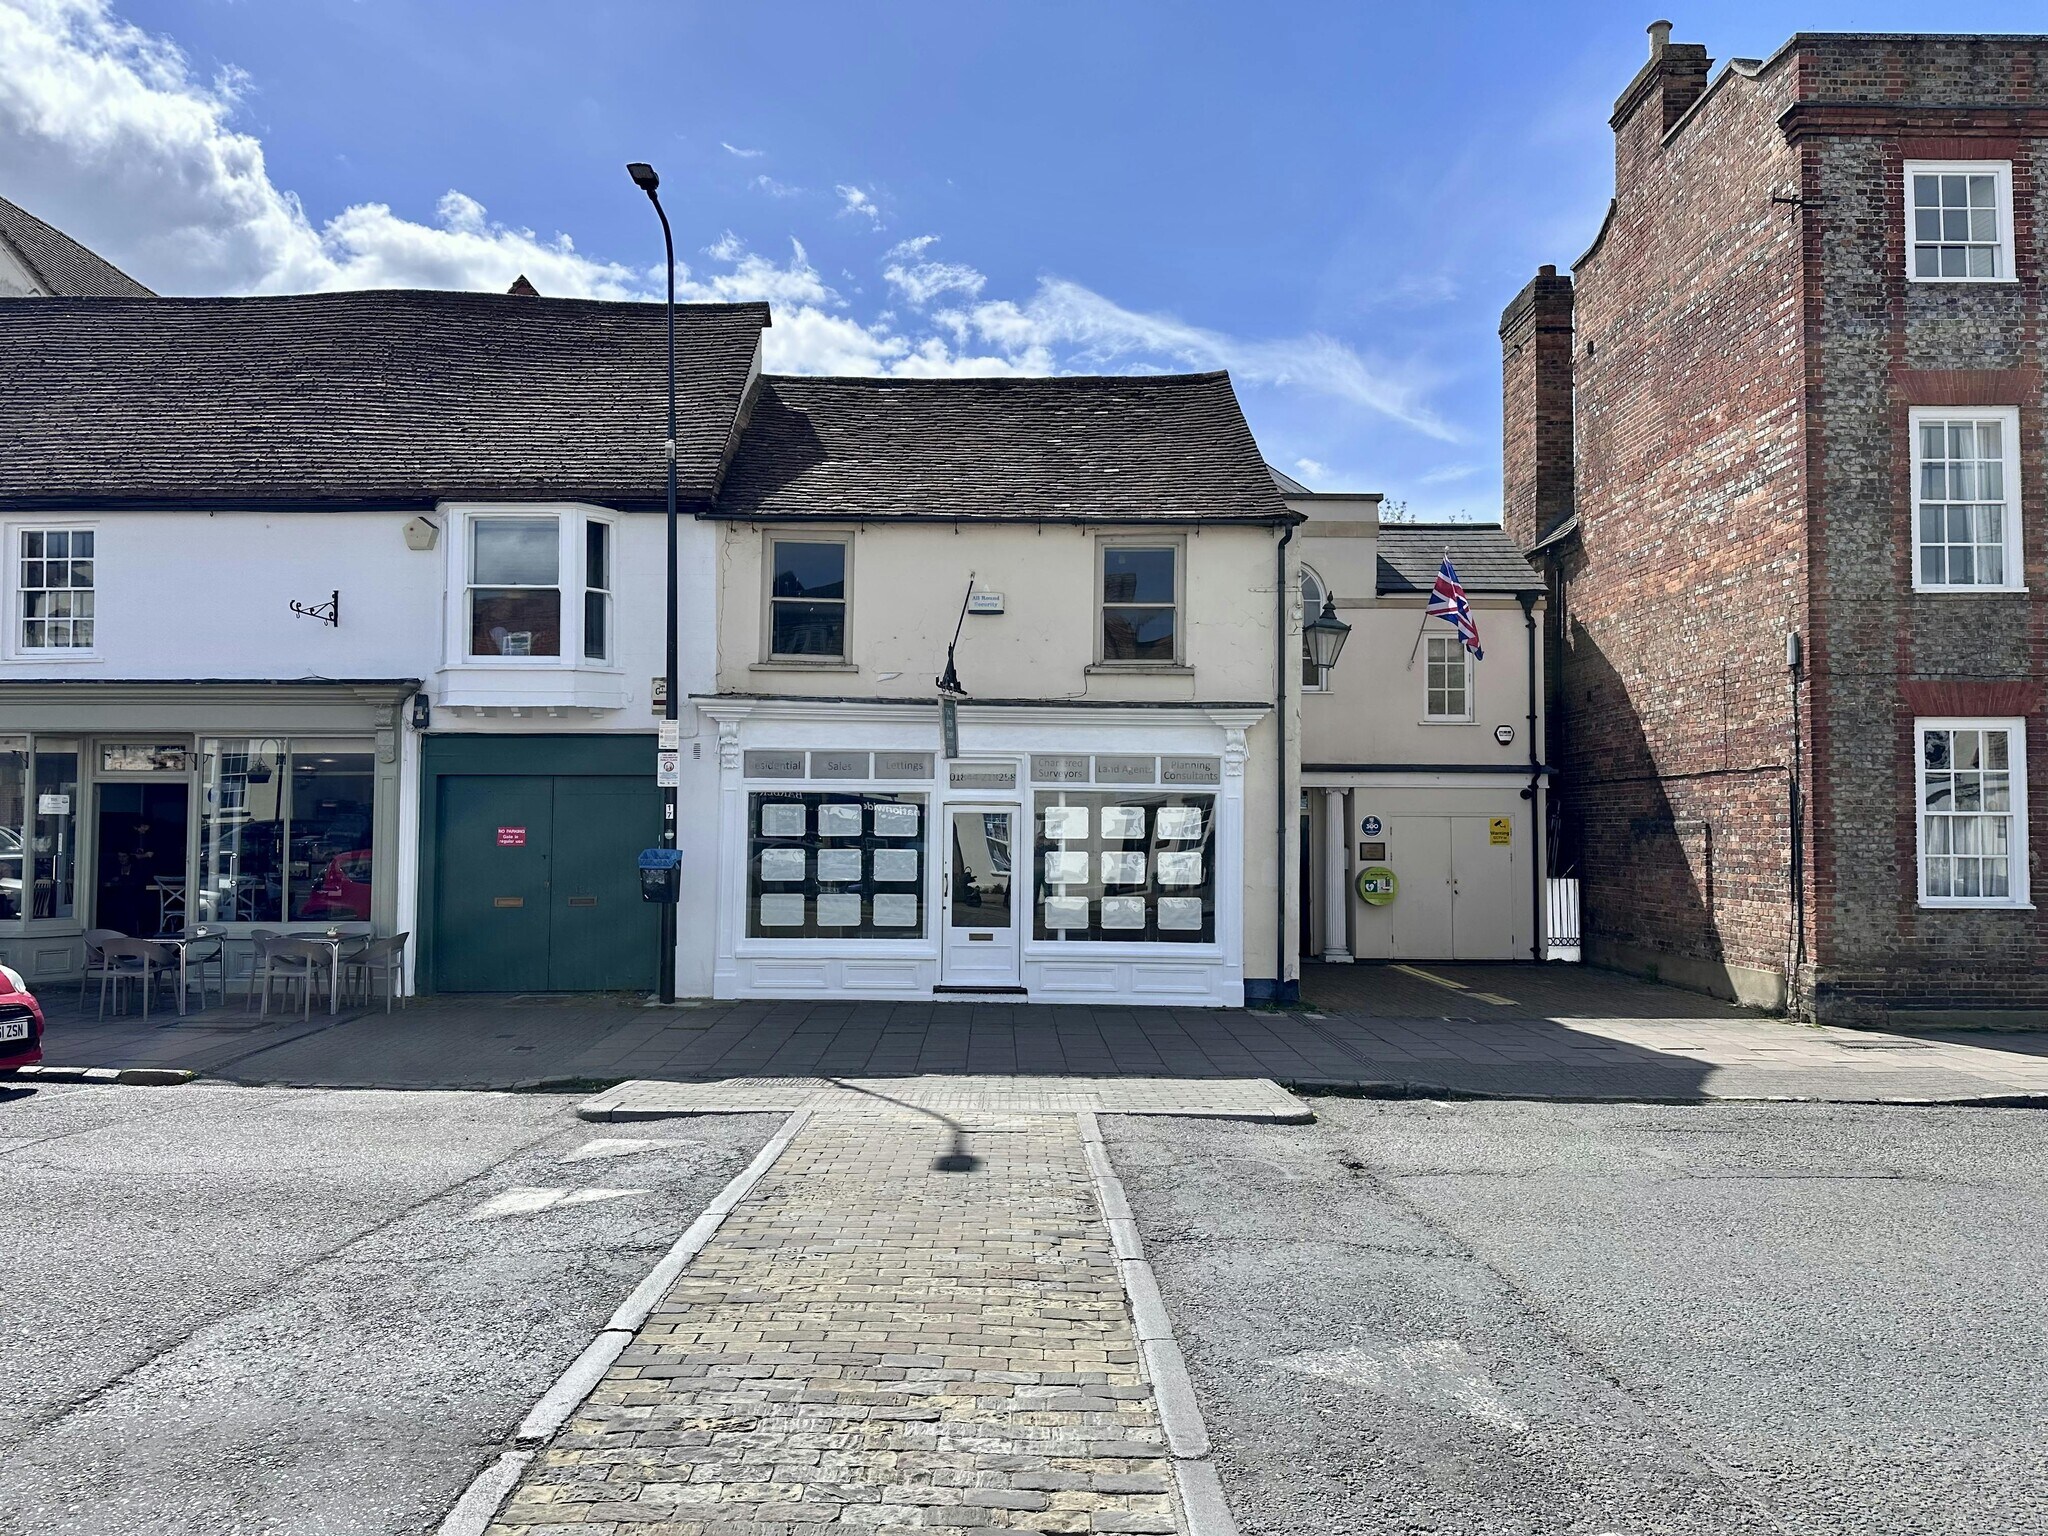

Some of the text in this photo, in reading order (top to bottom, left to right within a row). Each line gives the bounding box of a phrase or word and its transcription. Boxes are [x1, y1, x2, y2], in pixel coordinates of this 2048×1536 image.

[748, 760, 801, 771] esidential
[827, 761, 852, 771] Sales
[886, 761, 924, 771] Lettings
[1038, 758, 1083, 768] Charered
[1171, 759, 1211, 771] Planning
[1038, 768, 1083, 779] Surveyors
[1098, 764, 1153, 776] Land Agents
[1163, 770, 1218, 781] Consultants
[6, 1023, 24, 1037] ZSN
